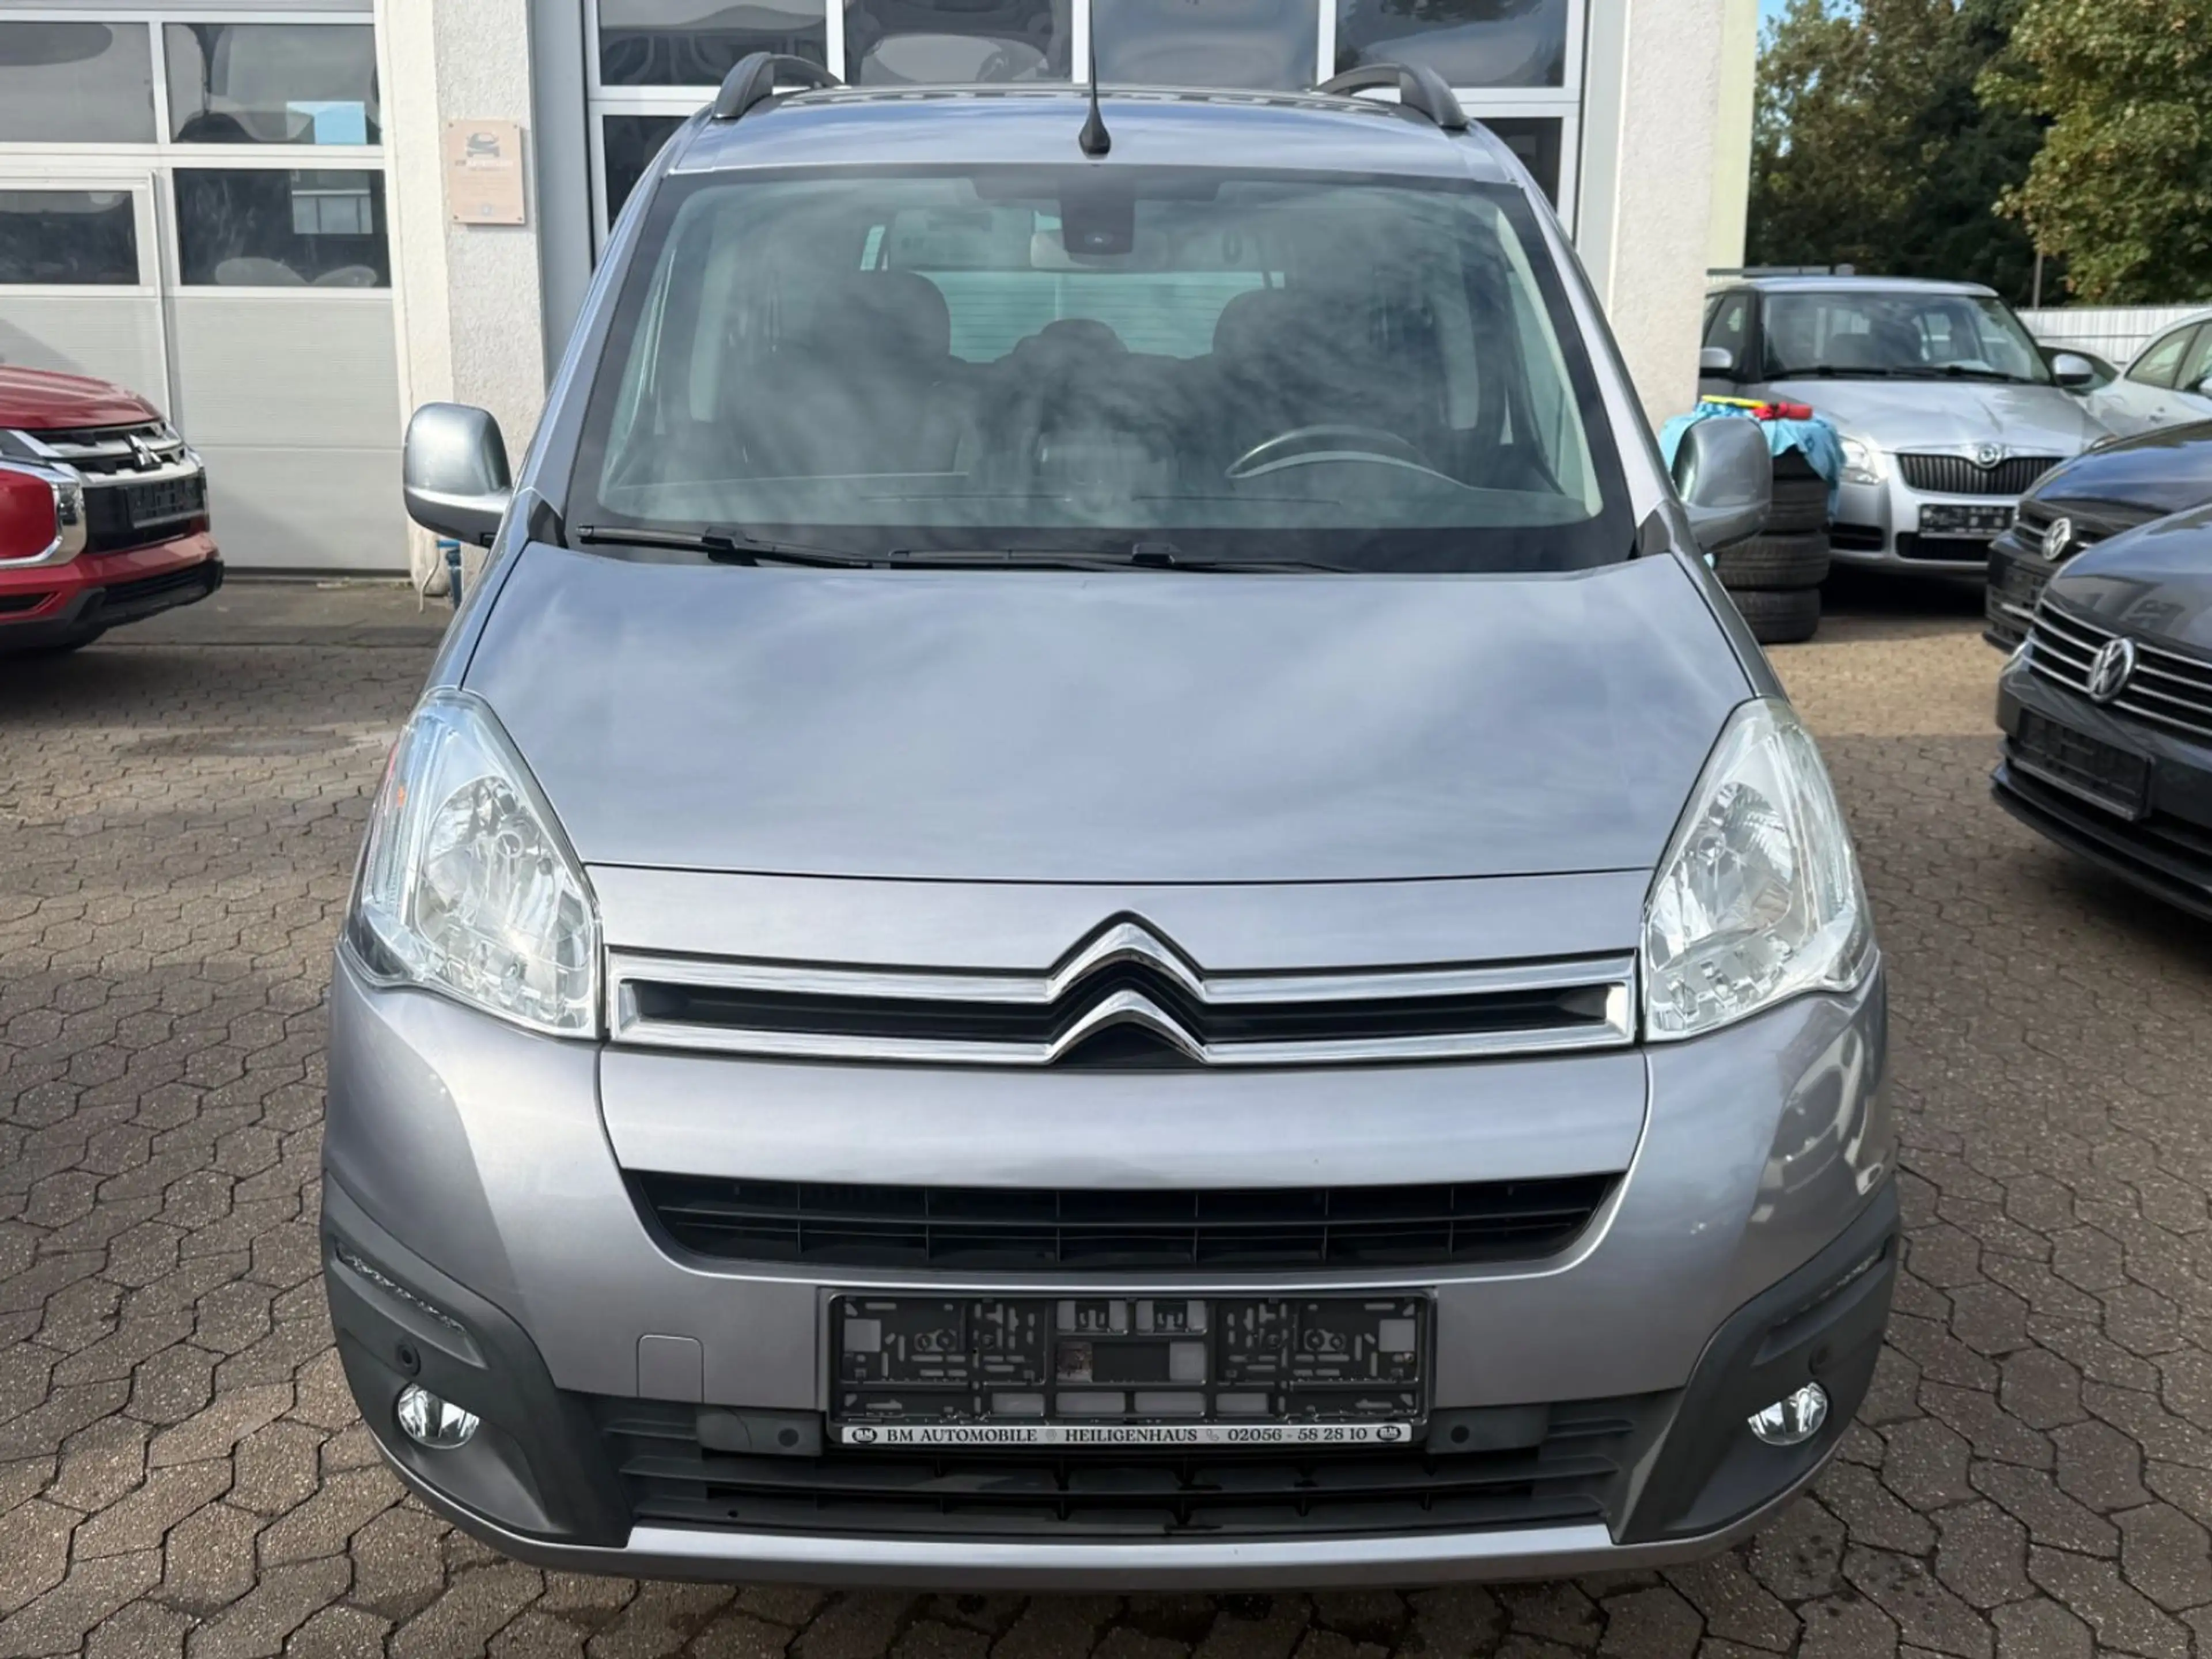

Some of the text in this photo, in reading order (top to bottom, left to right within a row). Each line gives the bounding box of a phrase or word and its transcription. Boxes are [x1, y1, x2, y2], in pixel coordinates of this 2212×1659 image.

[887, 1429, 914, 1441] BM
[921, 1429, 1037, 1441] AUTOMOBILE
[1065, 1429, 1198, 1441] HEILIGENHAUS
[1228, 1428, 1282, 1441] 02056
[1297, 1427, 1318, 1441] 58
[1323, 1427, 1344, 1440] 28
[1349, 1427, 1368, 1440] 10
